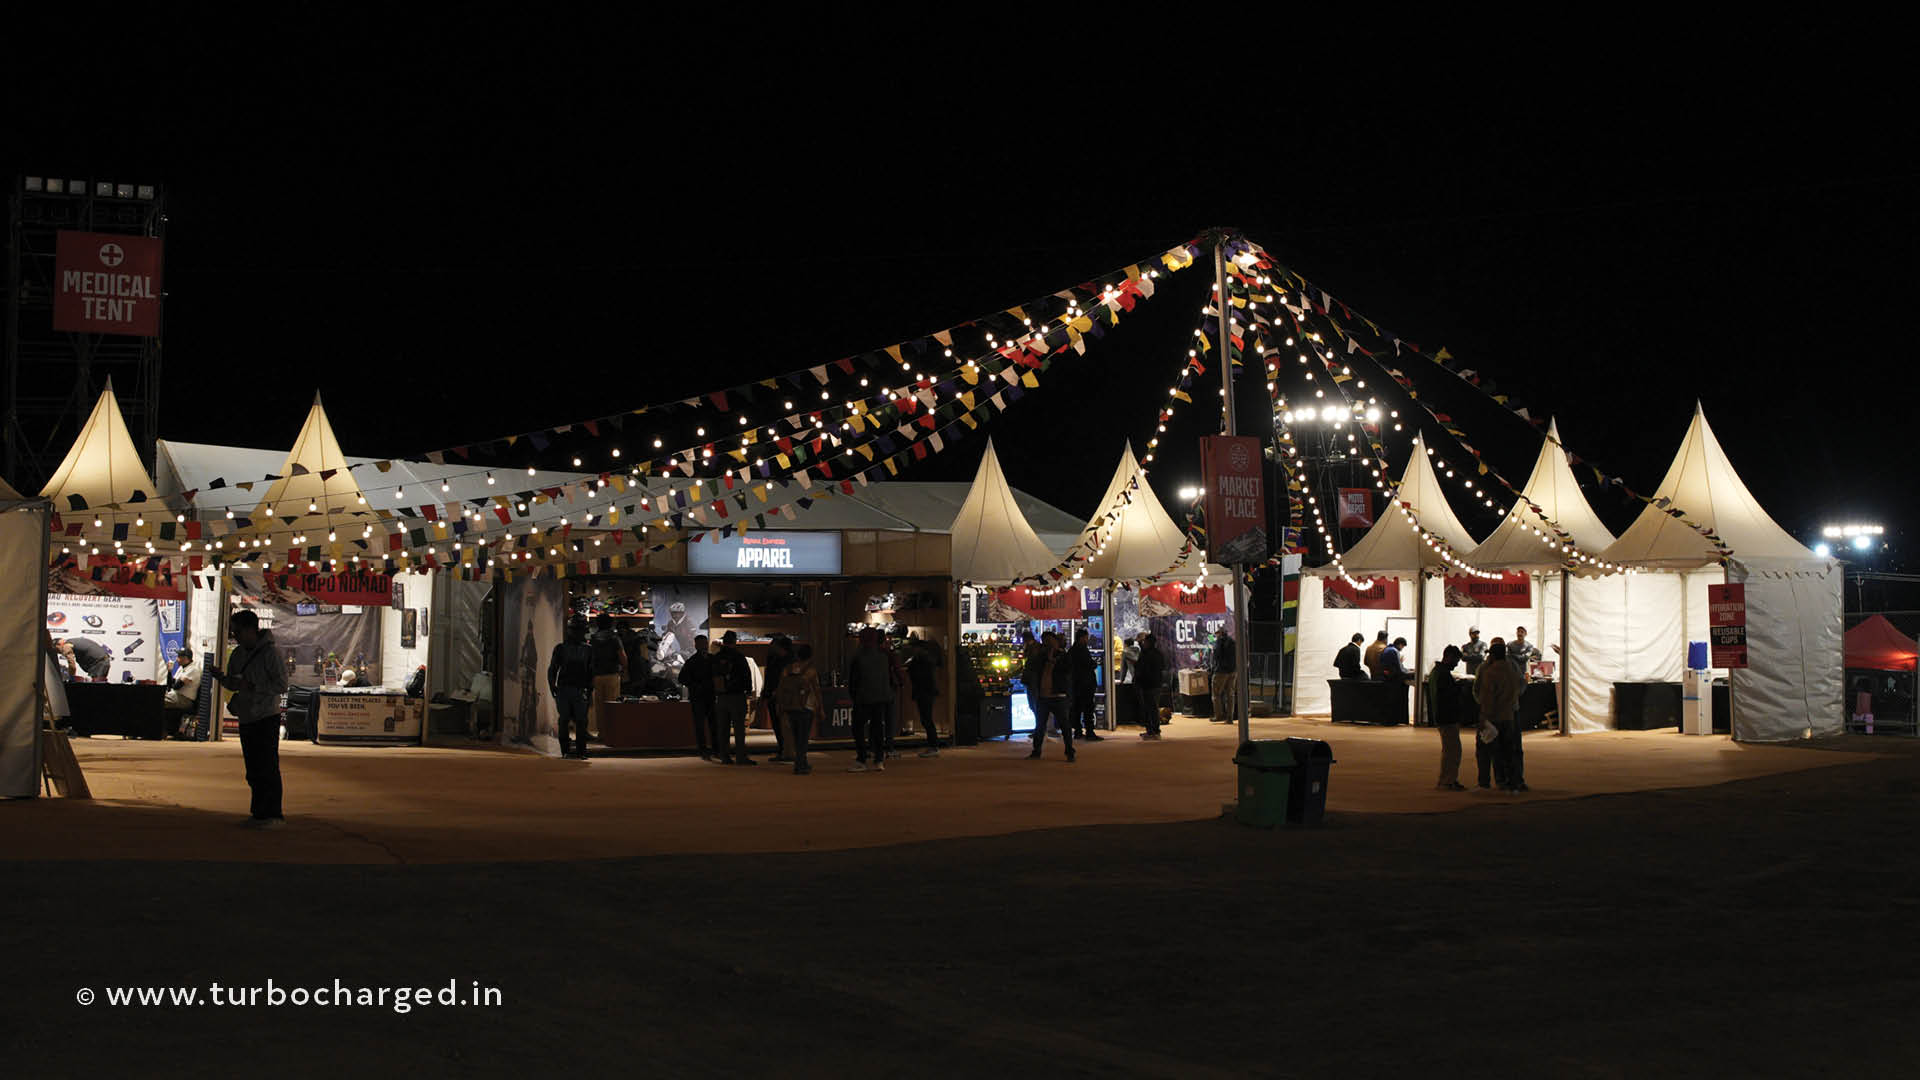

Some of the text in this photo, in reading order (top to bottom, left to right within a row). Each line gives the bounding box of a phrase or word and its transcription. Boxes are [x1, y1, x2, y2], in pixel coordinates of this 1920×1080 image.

[62, 269, 156, 299] MEDICAL
[80, 296, 137, 322] TENT
[1219, 475, 1260, 497] MARKET
[1224, 497, 1257, 518] PLACE
[736, 547, 793, 568] APPAREL
[339, 573, 388, 593] NOMAD
[1175, 619, 1197, 642] GET
